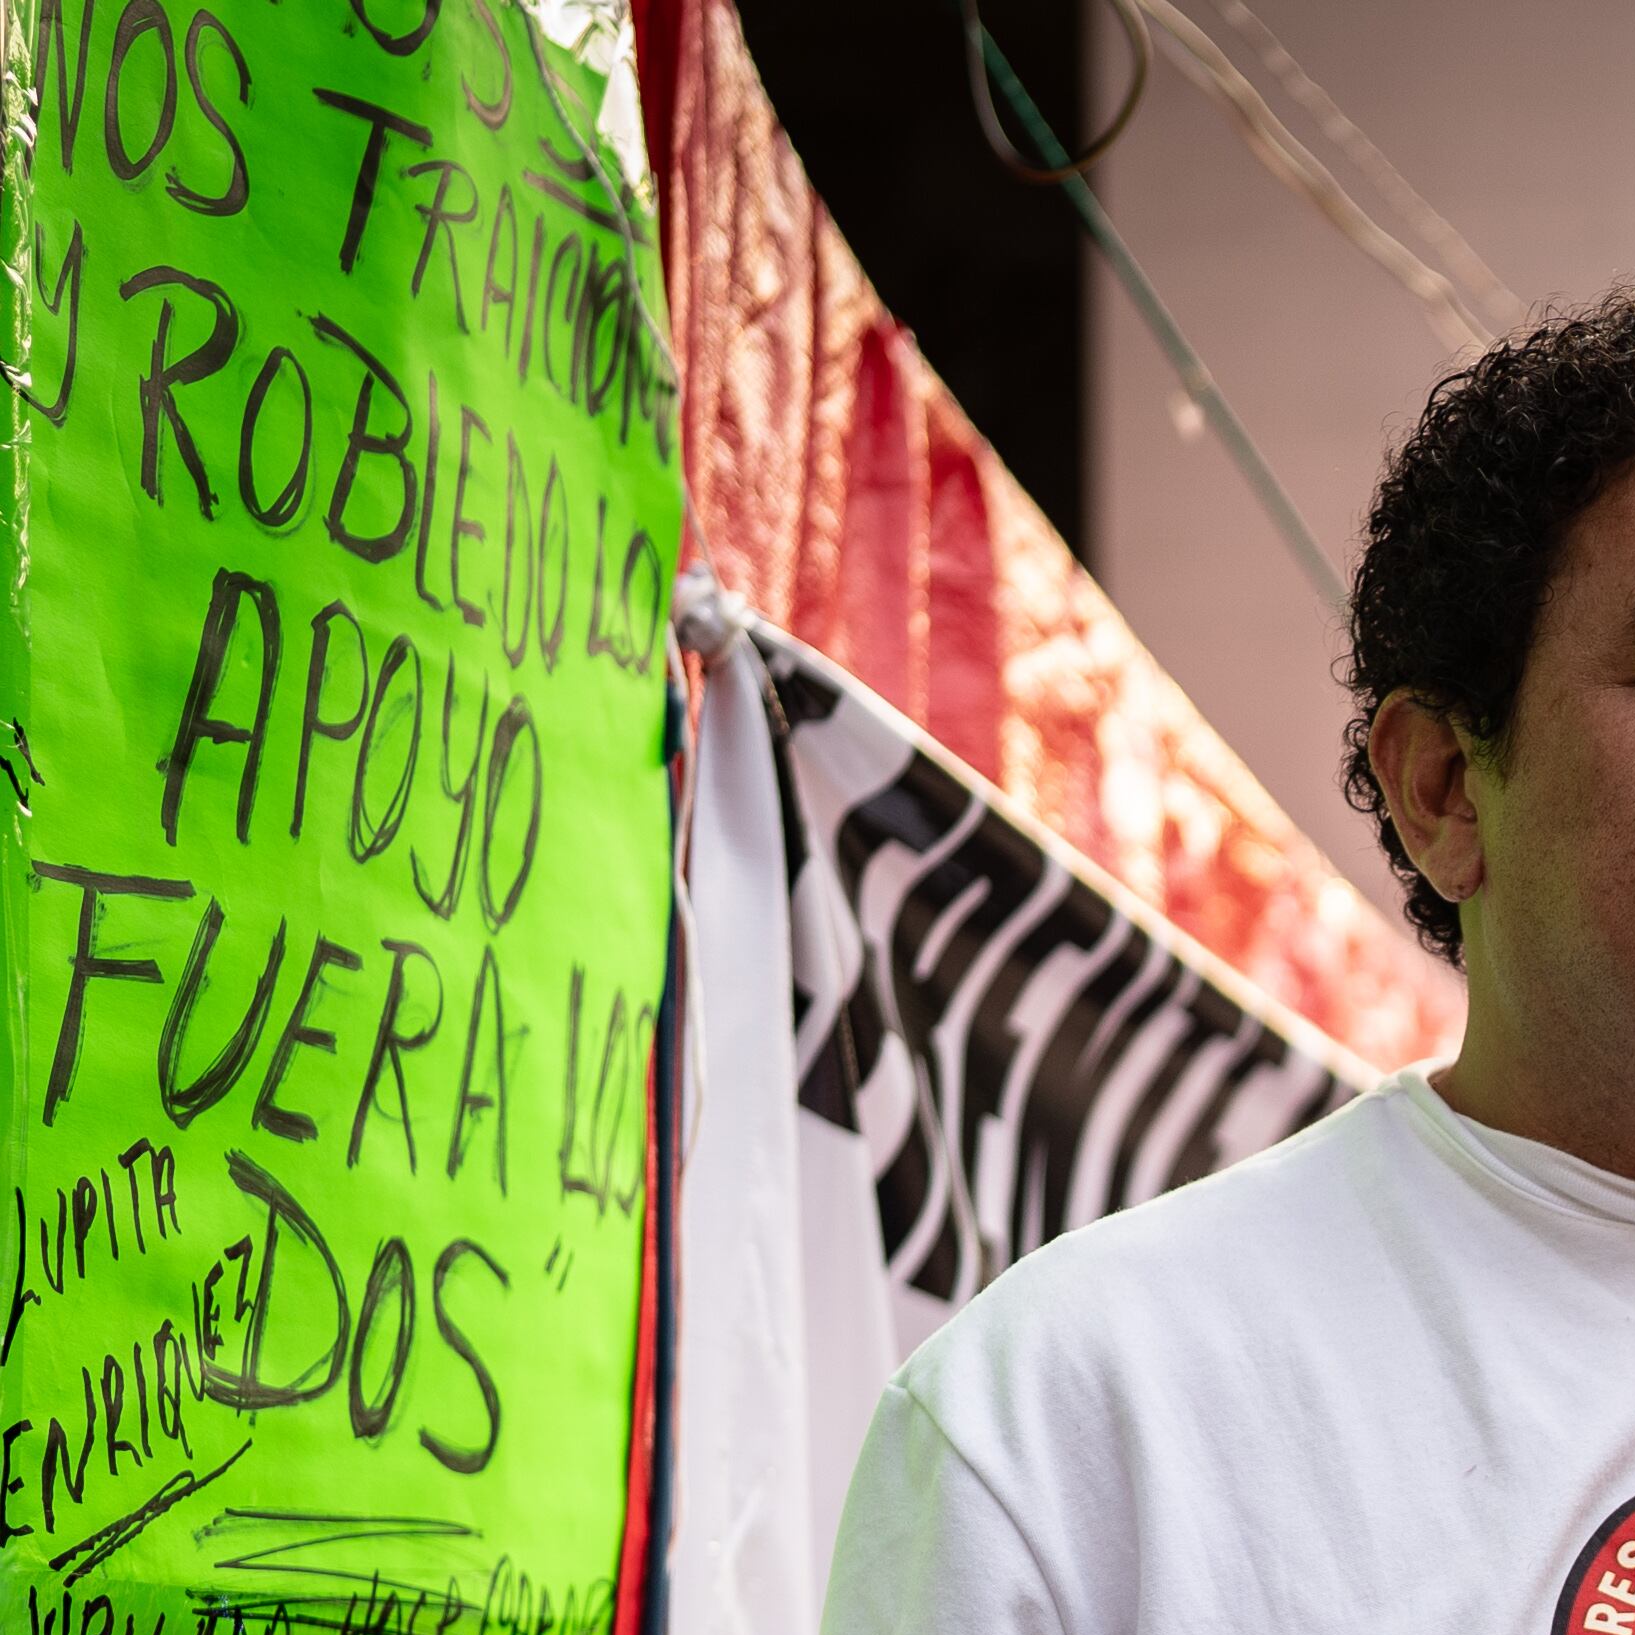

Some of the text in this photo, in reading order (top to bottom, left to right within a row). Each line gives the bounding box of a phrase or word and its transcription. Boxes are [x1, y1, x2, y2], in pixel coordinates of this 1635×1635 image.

[25, 0, 252, 217] NOS
[119, 265, 569, 675] ROBLEDO
[588, 497, 662, 677] LO
[156, 566, 543, 937] APOYO
[28, 860, 510, 1196] FUERA
[0, 1137, 181, 1366] LUPITA
[0, 1236, 258, 1548] ENRIQUEZ
